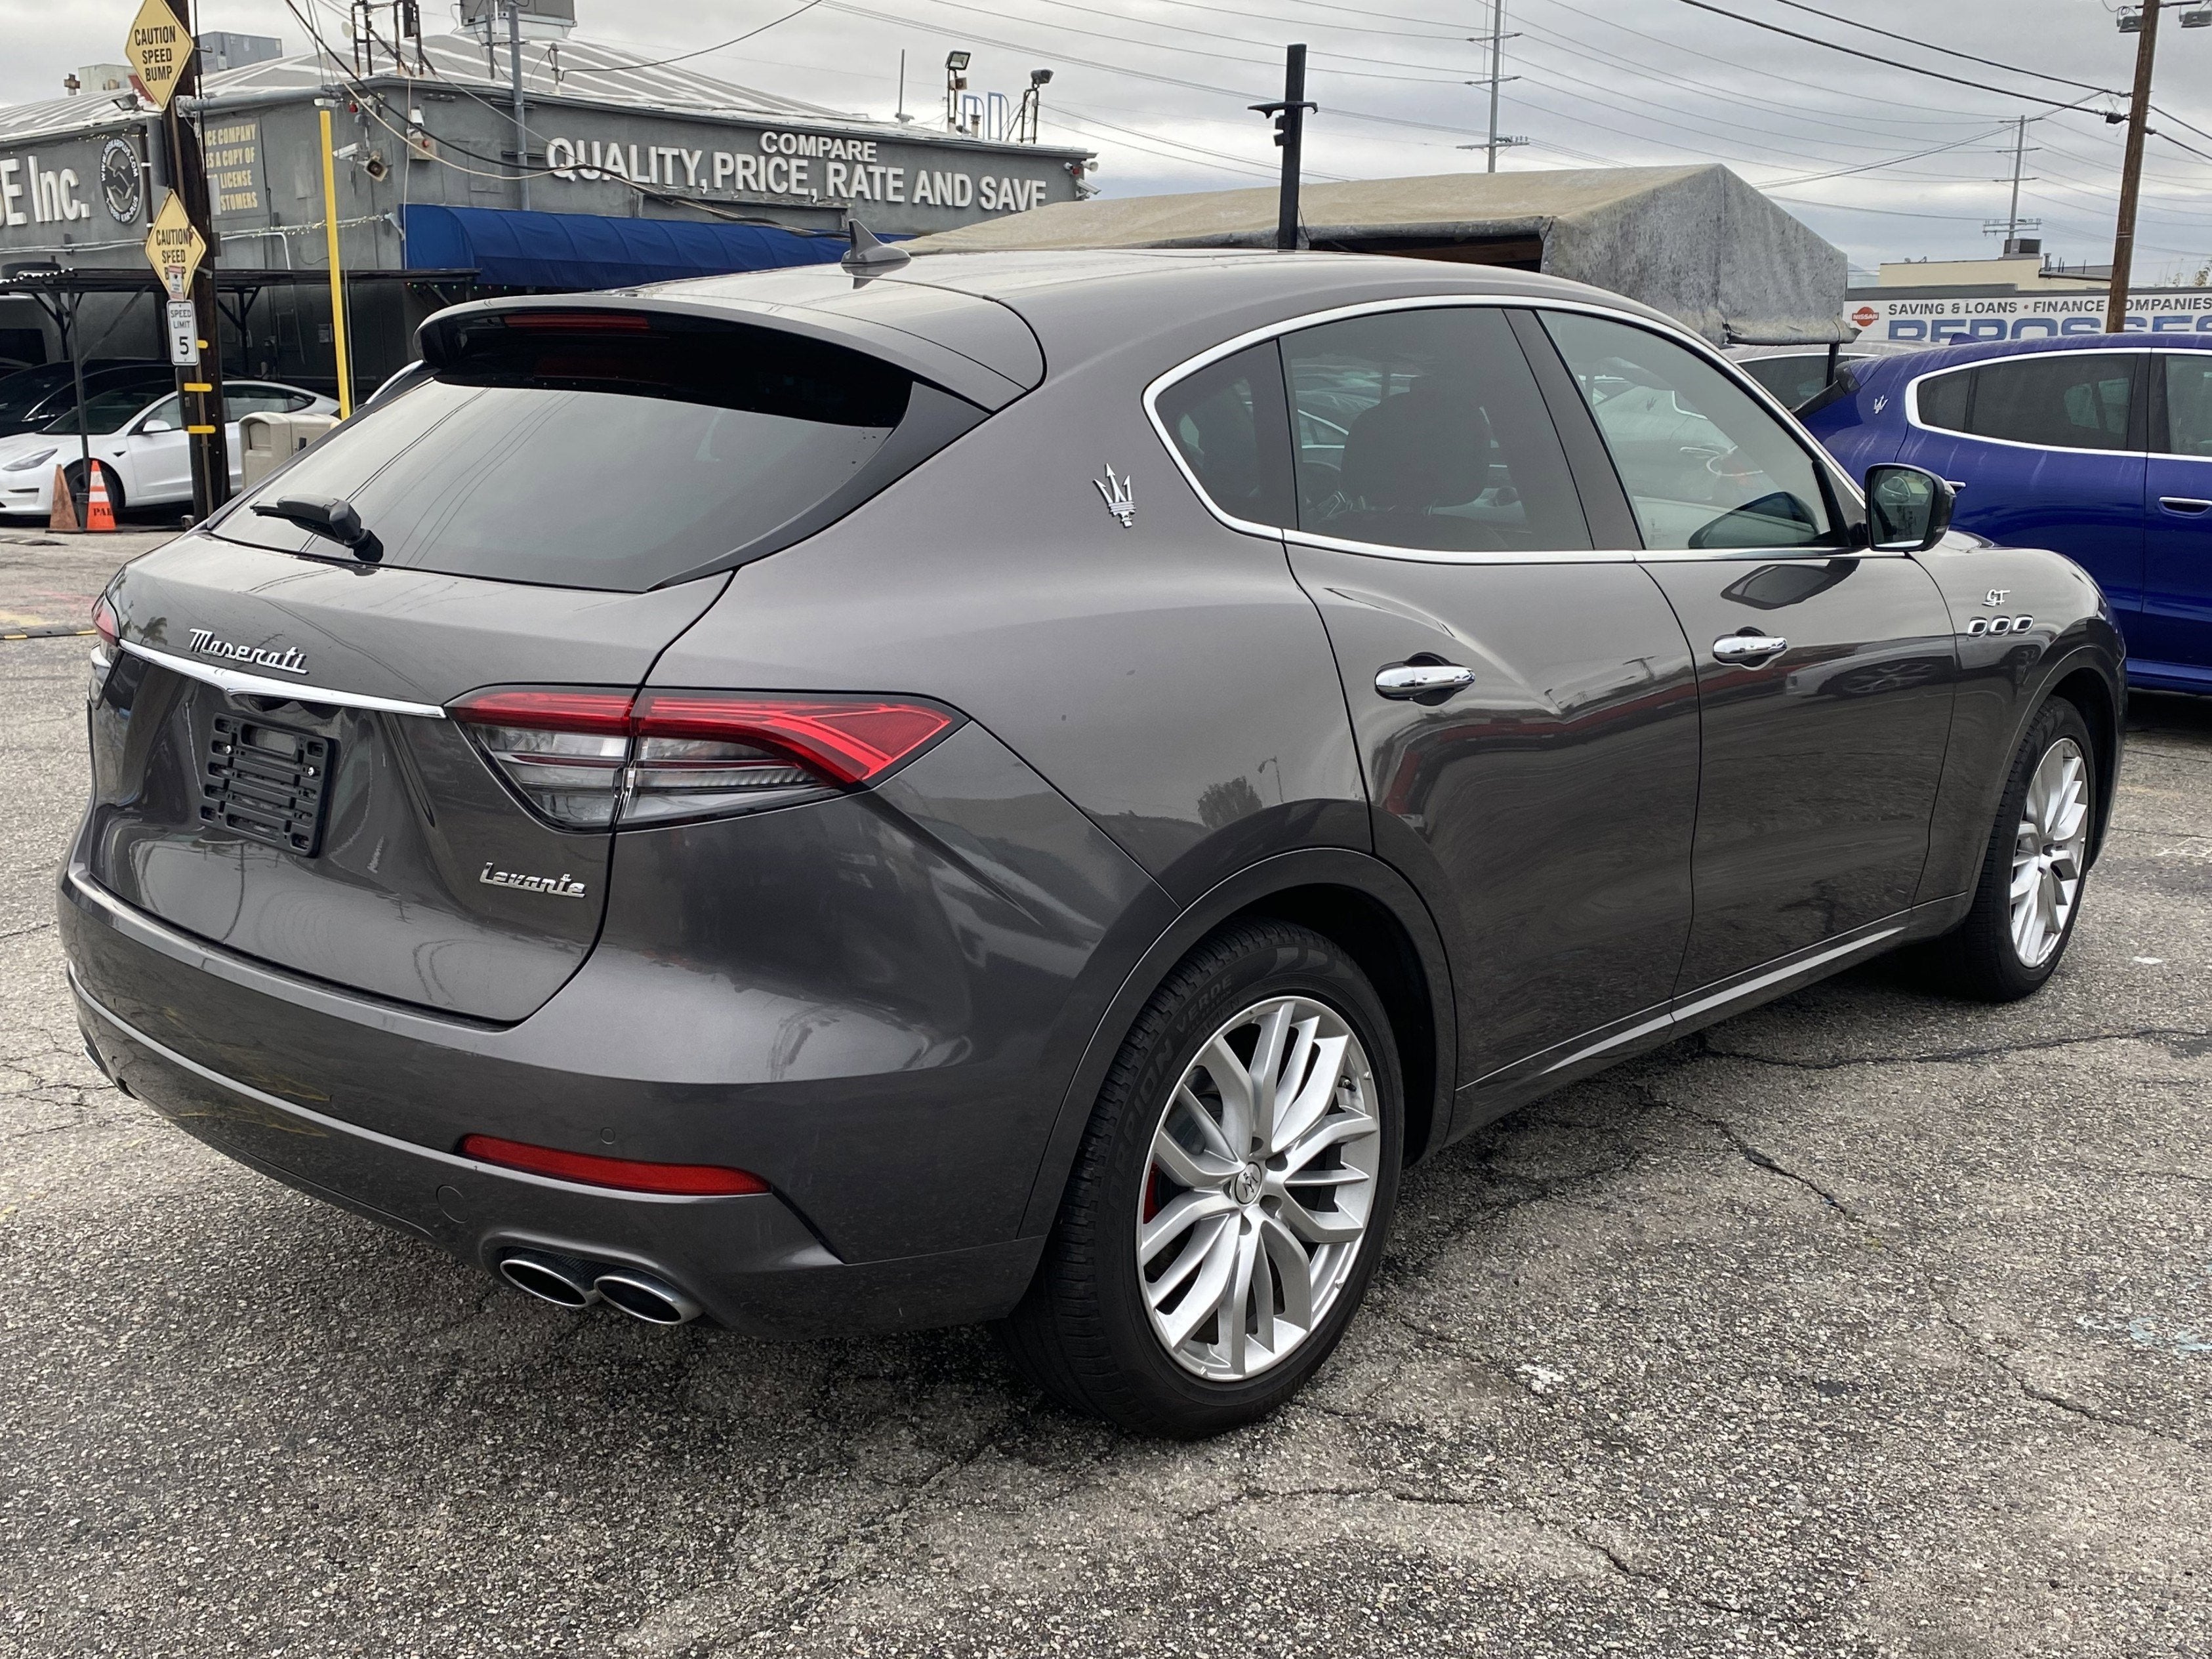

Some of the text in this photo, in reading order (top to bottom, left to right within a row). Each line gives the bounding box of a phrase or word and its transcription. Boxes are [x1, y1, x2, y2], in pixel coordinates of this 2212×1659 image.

[134, 26, 176, 46] CAUTION
[142, 48, 172, 64] SPEED
[145, 66, 172, 82] BUMP
[218, 124, 256, 145] COMPANY
[760, 131, 877, 162] COMPARE
[216, 151, 221, 167] A
[222, 148, 243, 166] COPY
[244, 146, 255, 164] OF
[220, 170, 252, 189] LICENSE
[546, 137, 1046, 211] QUALITY, PRICE, RATE AND SAVE
[0, 155, 90, 226] E Inc.
[156, 228, 188, 246] CAUTION
[161, 249, 186, 263] SPEED
[165, 266, 186, 280] BP
[171, 309, 191, 318] SPEED
[1888, 298, 2212, 316] SAVING & LOANS FINANCE OMPANIES
[173, 320, 190, 329] LIMIT
[179, 336, 189, 355] 5
[1982, 589, 2011, 607] GT
[189, 628, 309, 675] Maserati
[480, 861, 586, 898] Levante
